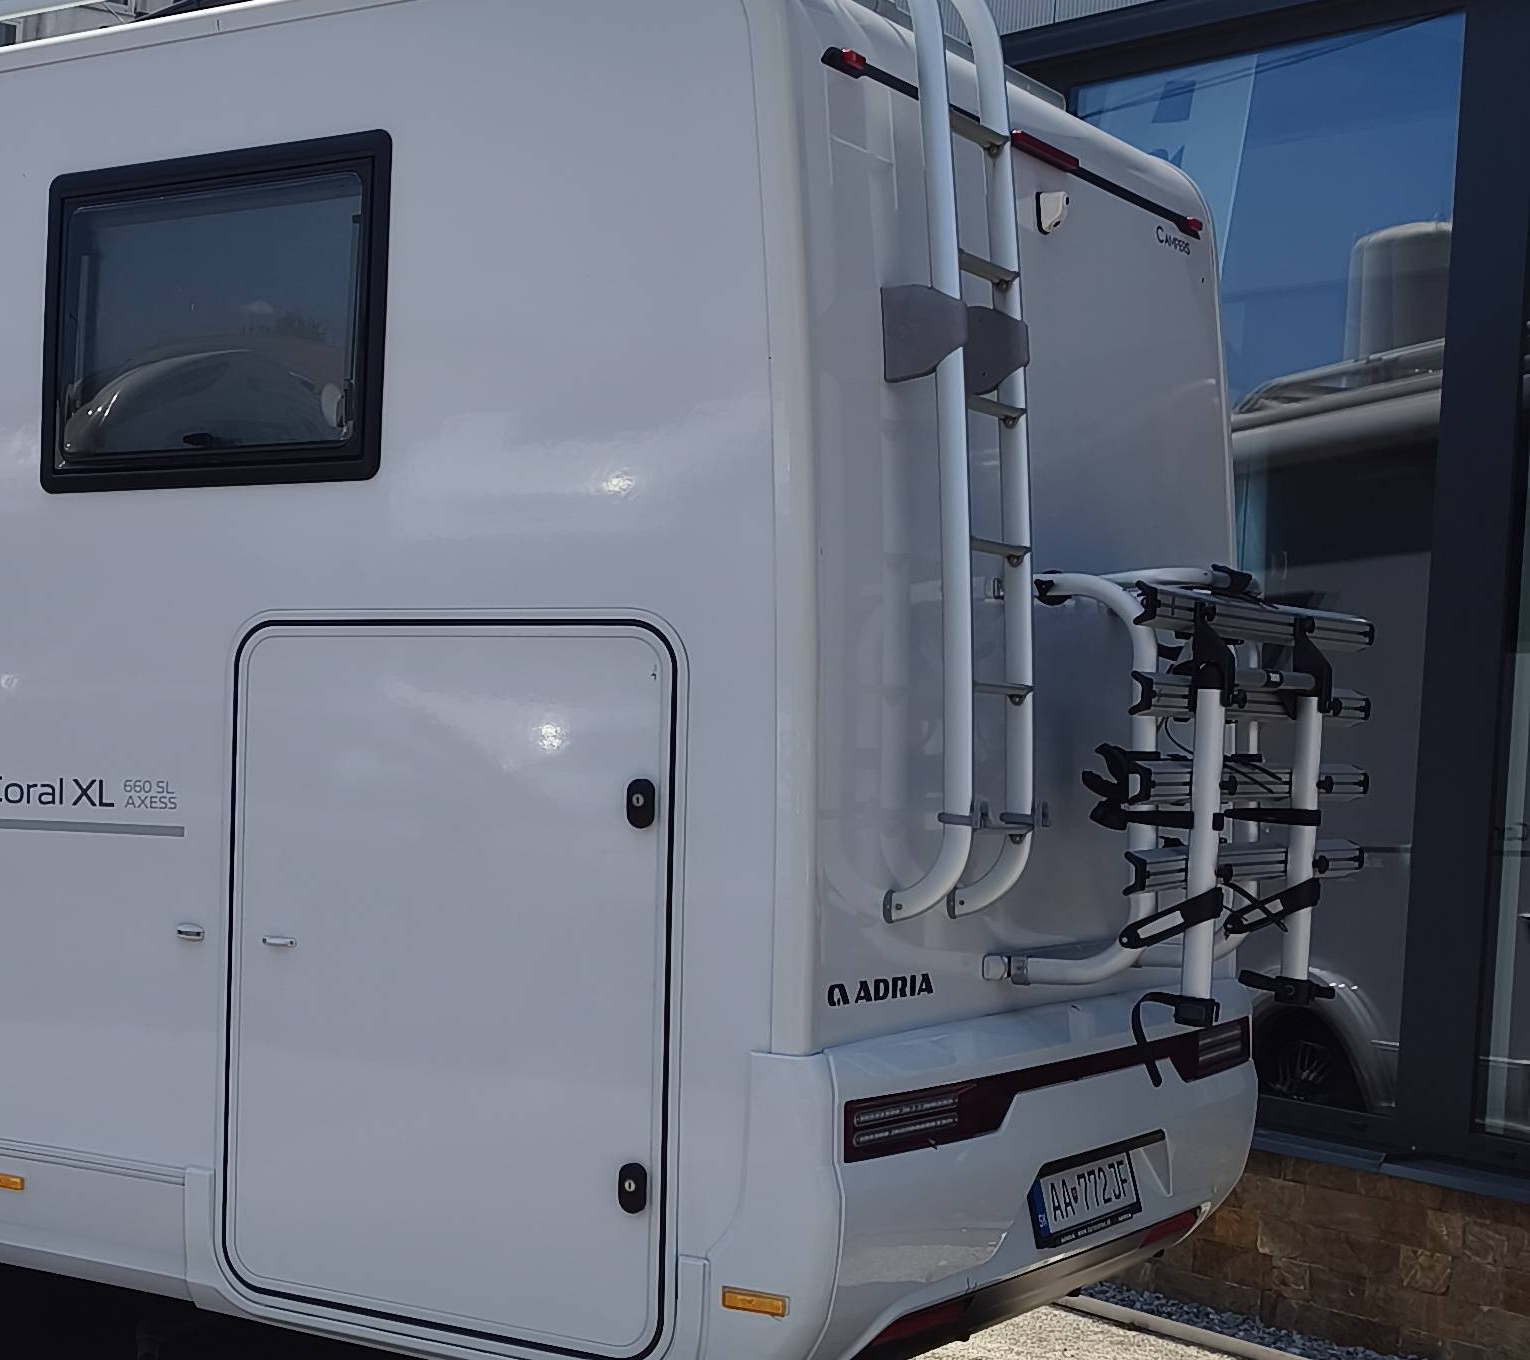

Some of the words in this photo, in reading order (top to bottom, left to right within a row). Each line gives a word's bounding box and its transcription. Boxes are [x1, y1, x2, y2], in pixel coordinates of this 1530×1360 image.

[71, 778, 115, 808] XL
[123, 779, 152, 794] 660
[155, 780, 175, 795] SL
[124, 795, 178, 810] AXESS
[854, 972, 934, 1004] ADRIA
